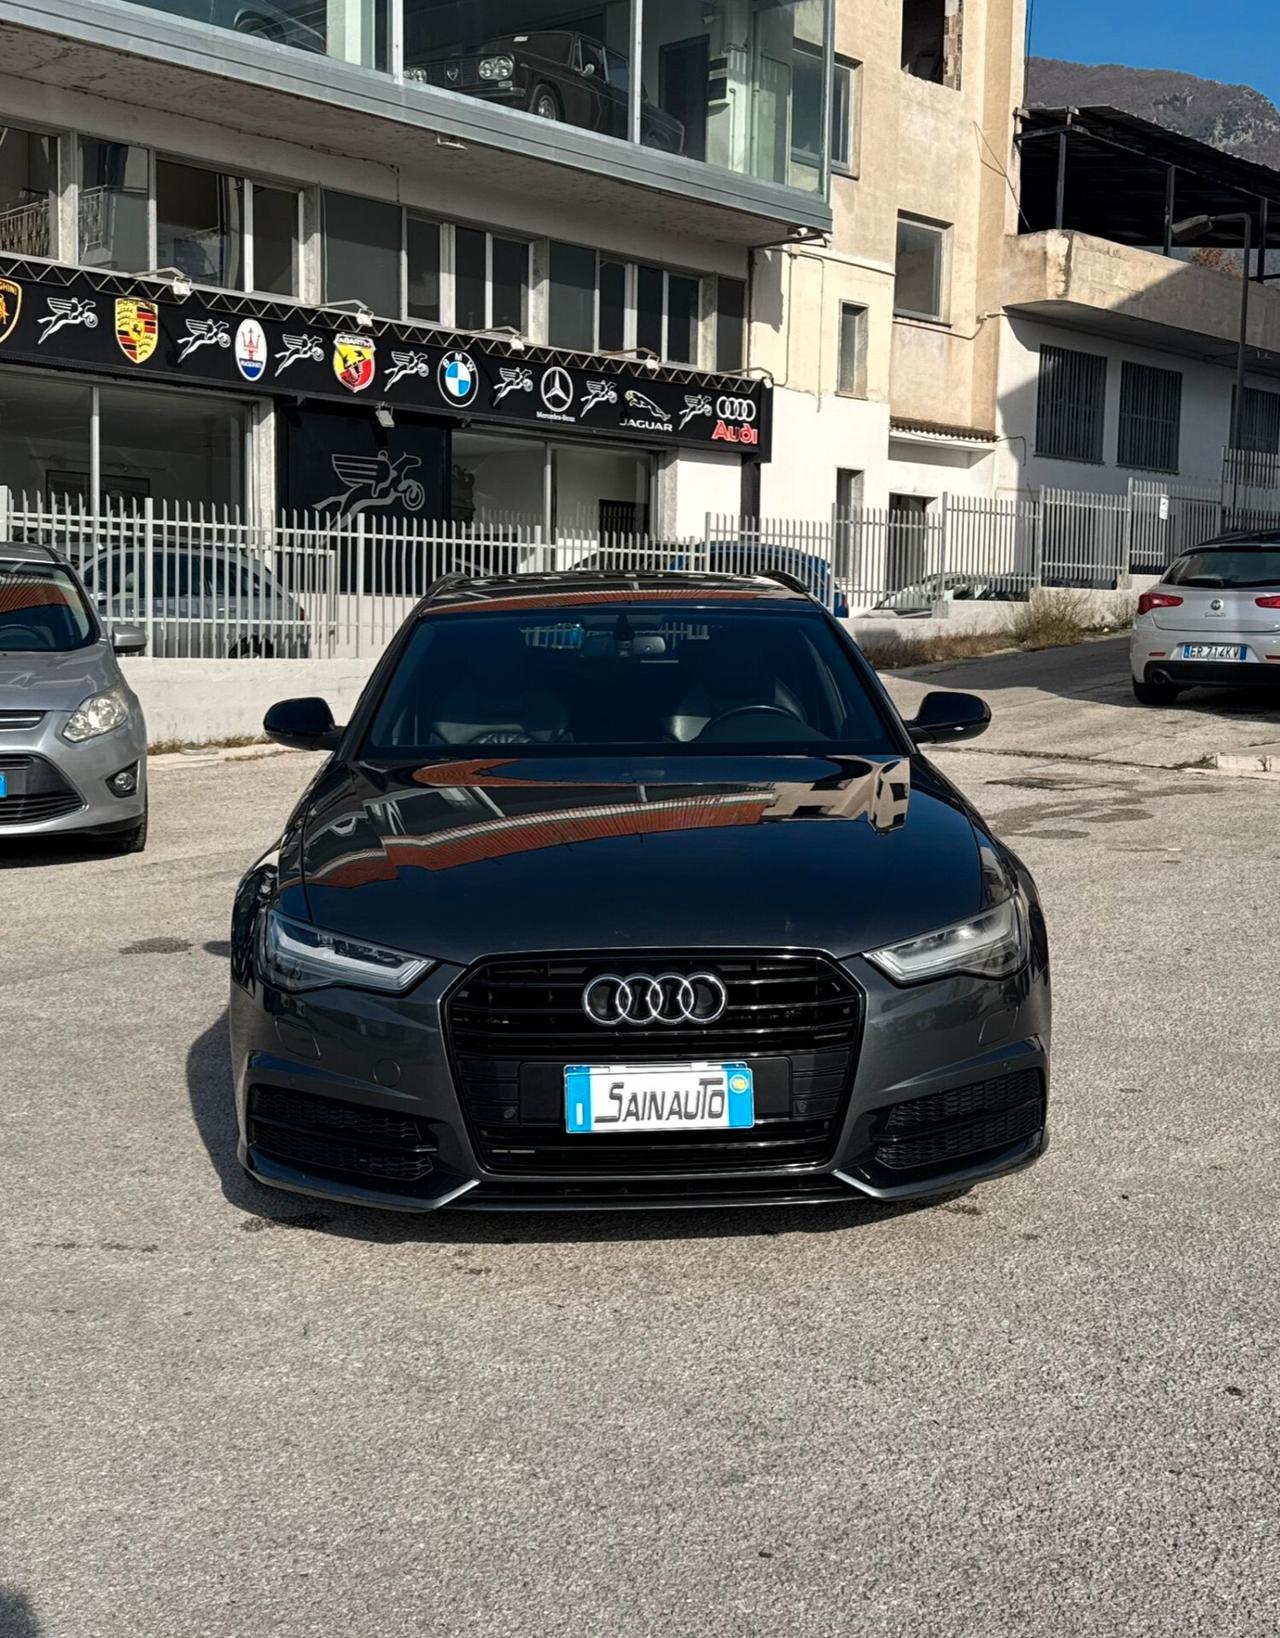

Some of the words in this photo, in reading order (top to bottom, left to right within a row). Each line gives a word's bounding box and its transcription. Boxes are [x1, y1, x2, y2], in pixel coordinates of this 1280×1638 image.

[337, 335, 372, 347] ABARTH
[442, 352, 475, 372] BMW
[619, 418, 673, 432] JAGUAR
[712, 420, 758, 444] Audi
